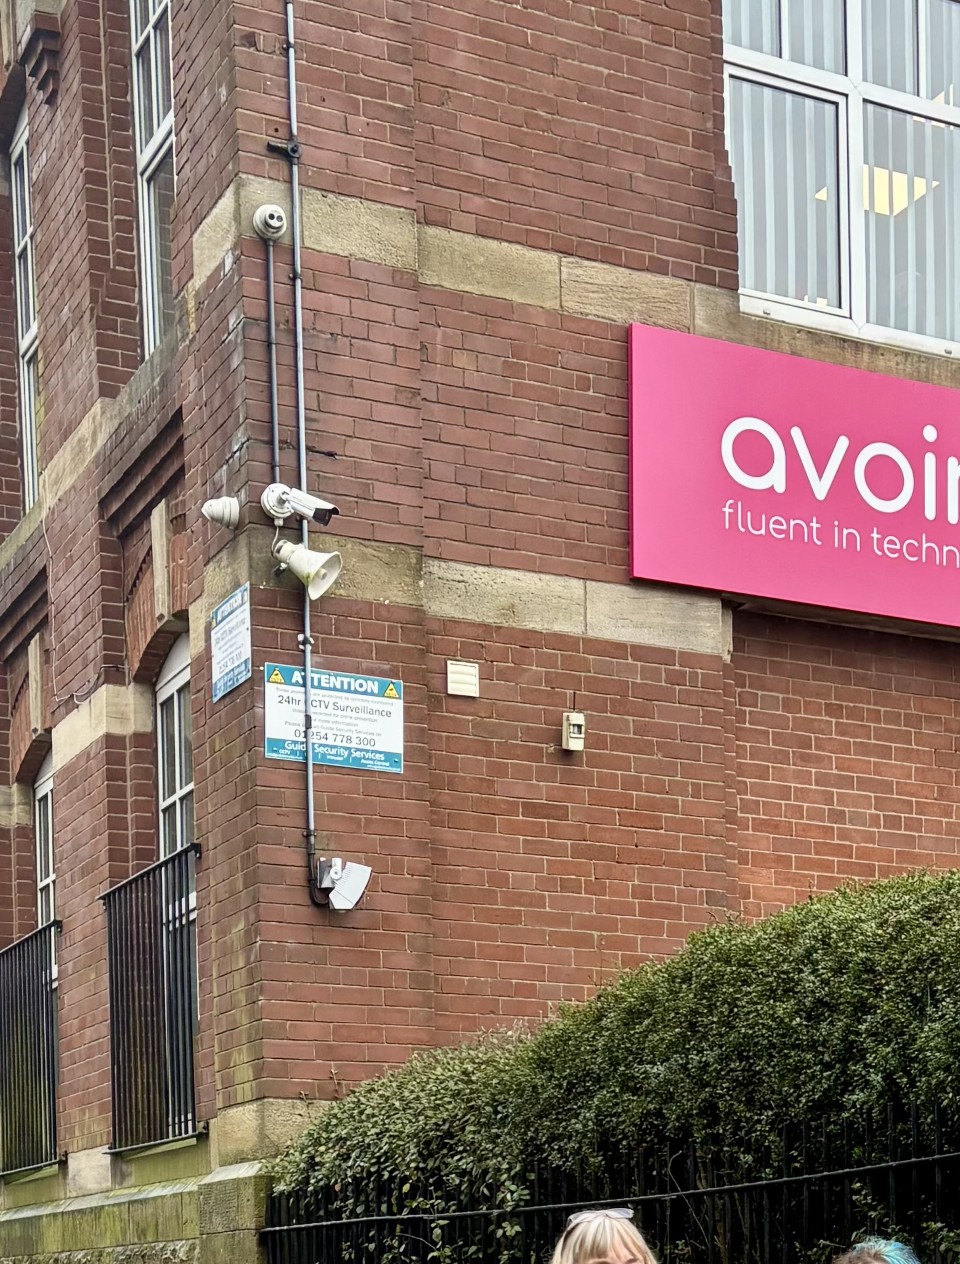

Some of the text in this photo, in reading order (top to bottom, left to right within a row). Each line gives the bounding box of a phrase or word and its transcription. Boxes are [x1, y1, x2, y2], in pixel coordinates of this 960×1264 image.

[721, 500, 823, 546] fluent
[833, 520, 861, 552] in
[291, 670, 379, 694] ATENTION
[277, 694, 392, 718] 24hr CTV Surveillance
[284, 740, 307, 751] Guid
[313, 743, 349, 758] Security
[350, 748, 385, 760] Services
[332, 733, 353, 745] 778
[355, 736, 376, 747] 300
